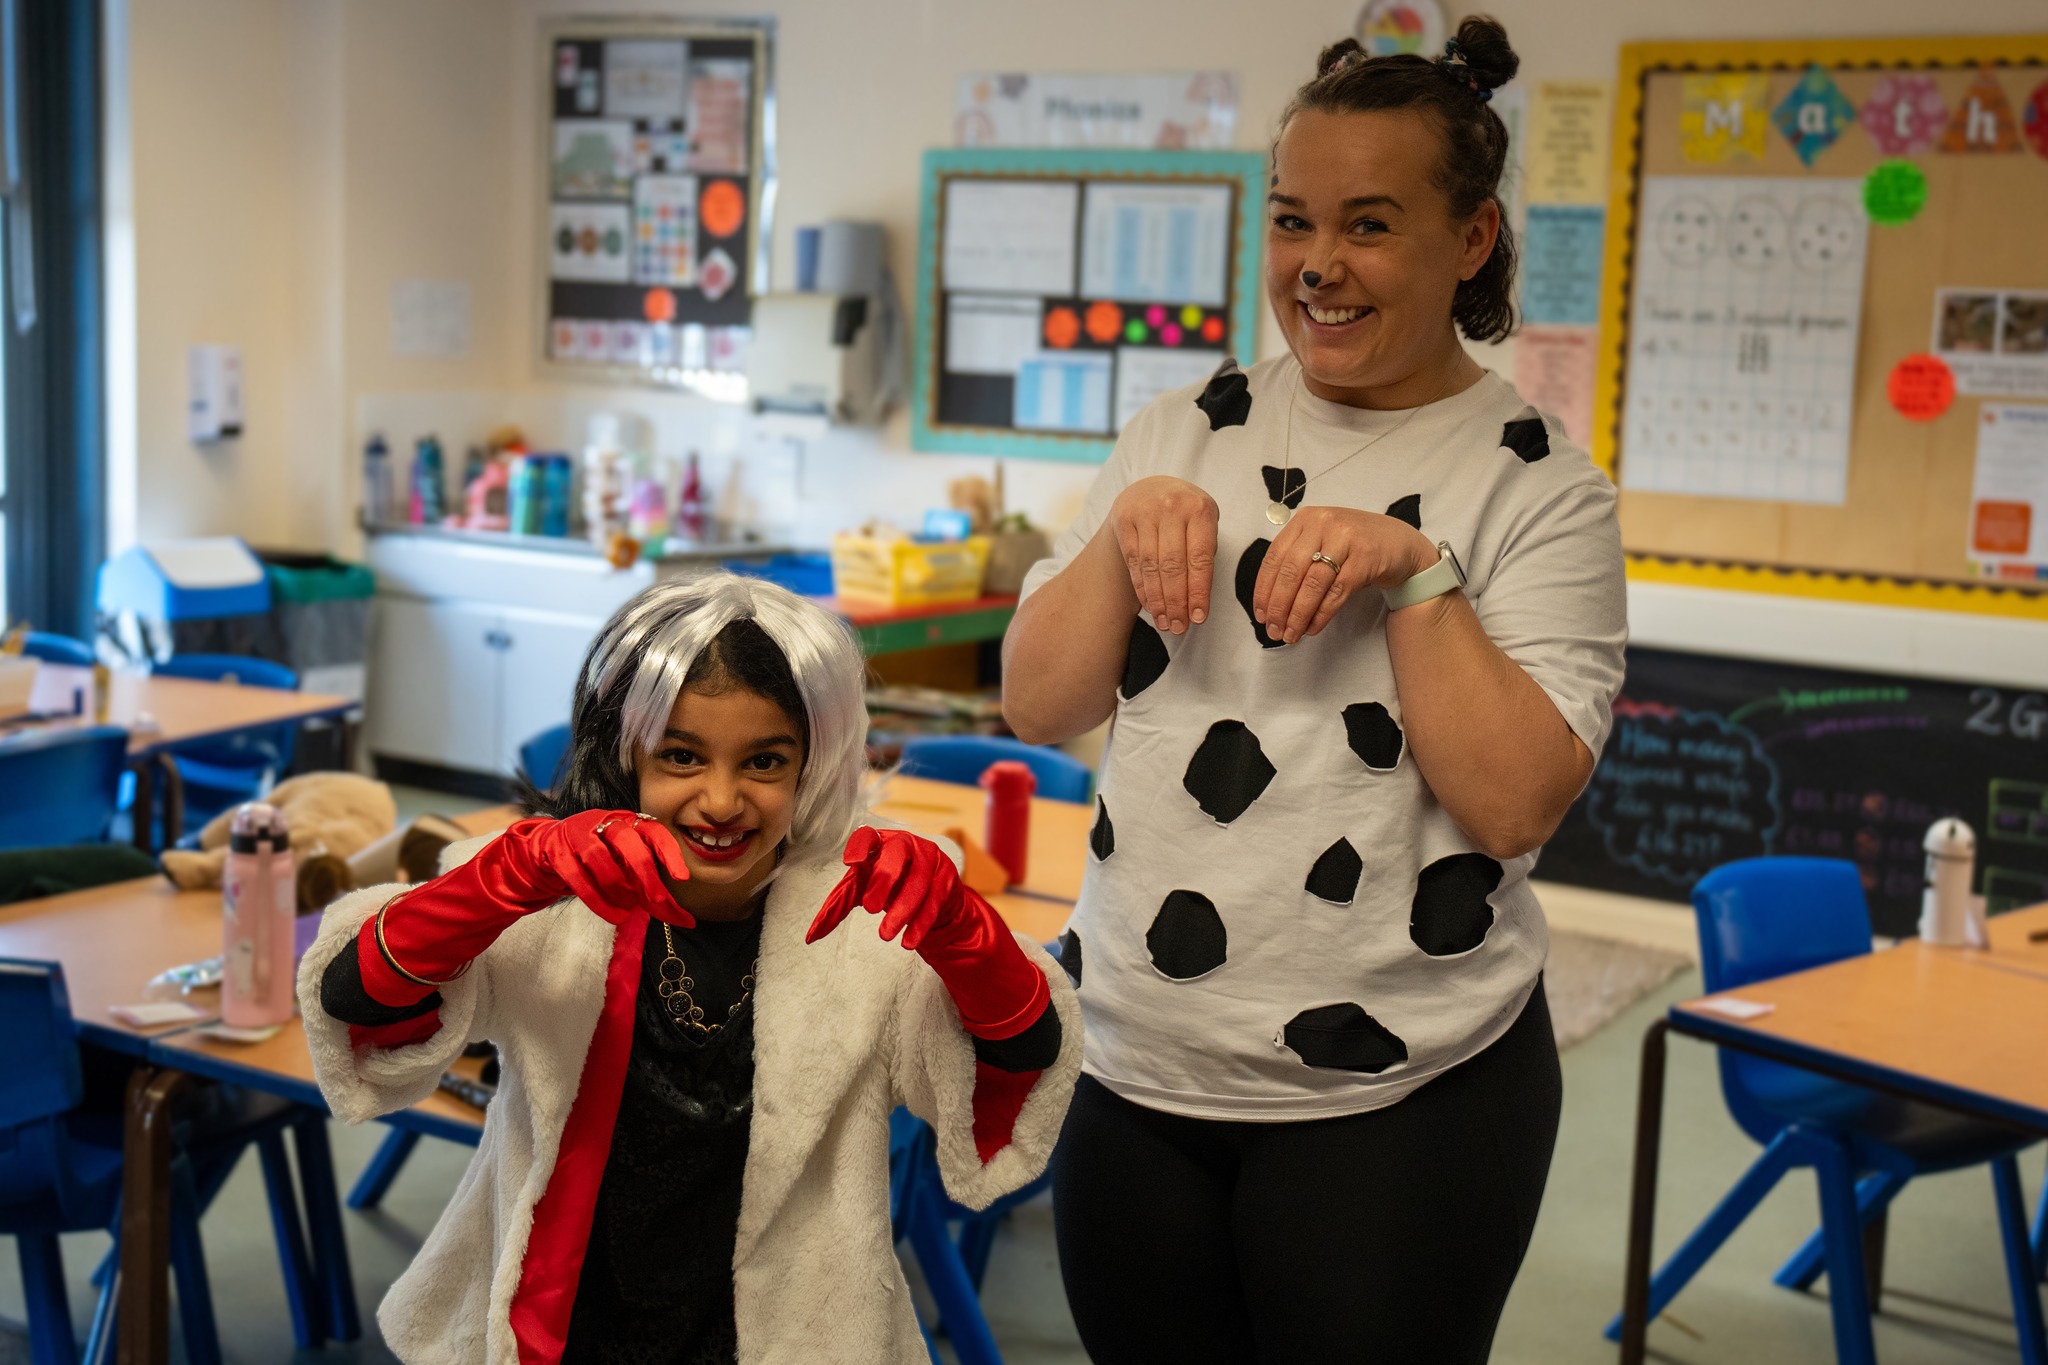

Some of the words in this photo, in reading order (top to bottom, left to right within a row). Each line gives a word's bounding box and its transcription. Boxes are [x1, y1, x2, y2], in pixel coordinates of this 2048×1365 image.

[1966, 687, 2048, 741] 2G
[1620, 722, 1669, 758] How
[1678, 739, 1744, 776] many
